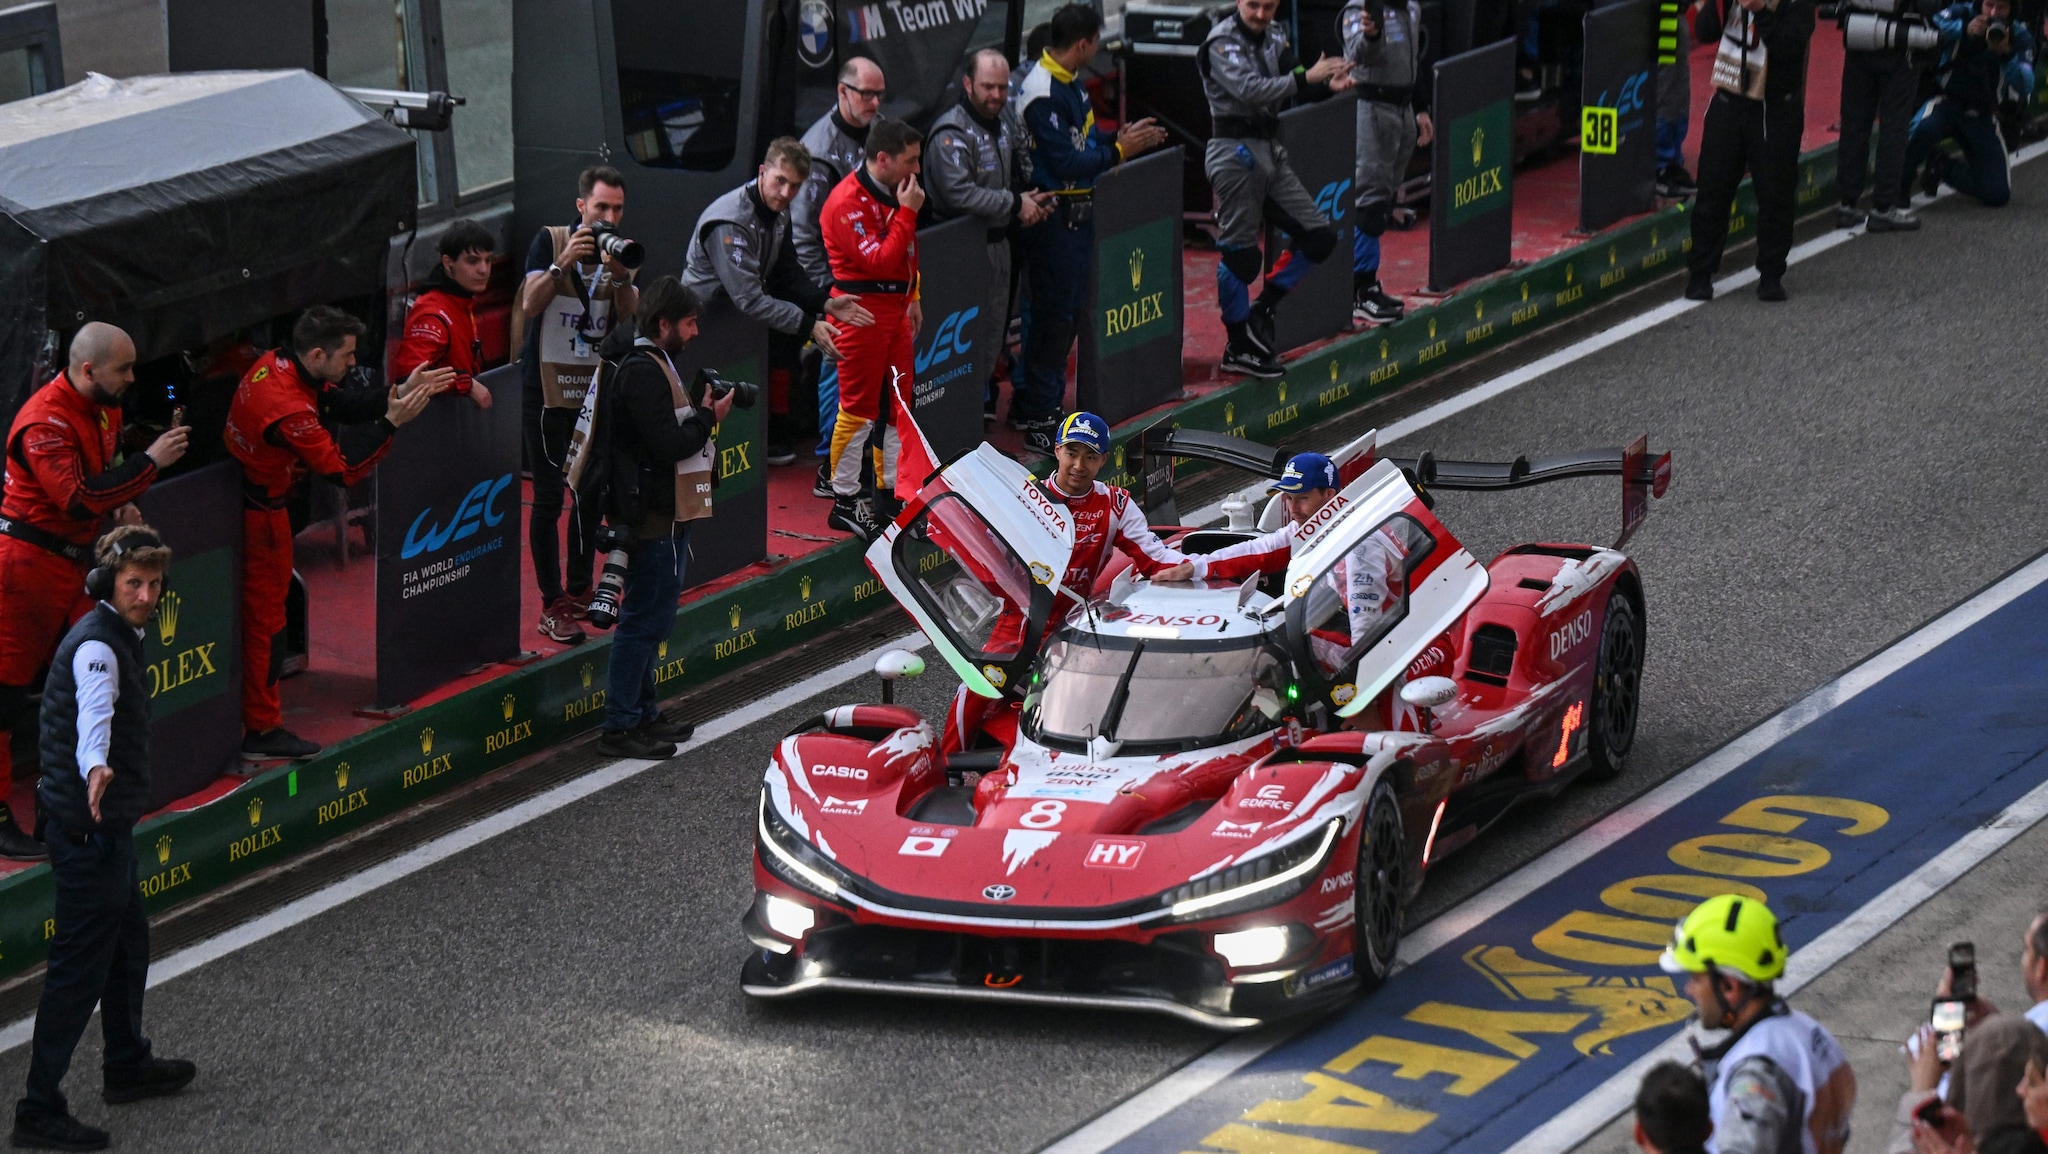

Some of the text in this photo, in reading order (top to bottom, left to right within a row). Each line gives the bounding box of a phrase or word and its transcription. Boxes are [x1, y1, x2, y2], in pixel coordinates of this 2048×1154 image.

[887, 0, 950, 33] Team
[1586, 113, 1613, 147] 38
[1315, 177, 1351, 220] EC
[1454, 166, 1502, 209] ROLEX
[1600, 266, 1626, 289] ROLEX
[1556, 283, 1583, 307] ROLEX
[1105, 291, 1163, 337] ROLEX
[1512, 303, 1539, 325] ROLEX
[1466, 321, 1493, 344] ROLEX
[1418, 339, 1447, 364] ROLEX
[1370, 361, 1399, 386] ROLEX
[913, 380, 933, 396] ORLD
[914, 387, 945, 408] PIONSHIP
[1319, 382, 1350, 407] ROLEX
[1267, 403, 1299, 429] ROLEX
[401, 472, 512, 560] WEC
[1023, 479, 1066, 533] TOYOTA
[1294, 495, 1349, 542] TOYOTA
[1076, 523, 1096, 532] ZENT
[403, 537, 503, 585] FIA WORLD ENDURANCE
[918, 550, 956, 575] ROLE
[402, 565, 470, 600] CHAMPIONSHIP
[854, 575, 885, 603] ROLE
[785, 600, 827, 631] ROLEX
[1104, 610, 1220, 626] DENSO
[715, 629, 757, 661] ROLEX
[1550, 609, 1592, 661] DENSO
[89, 661, 108, 674] FIA
[146, 642, 216, 699] OLEX
[654, 658, 686, 686] OLEX
[485, 719, 532, 754] ROLEX
[402, 752, 452, 788] ROLEX
[812, 764, 868, 781] CASIO
[1045, 778, 1098, 787] ZENT
[318, 788, 368, 825] ROLEX
[820, 806, 863, 815] MARELLI
[1019, 799, 1067, 829] 8
[1239, 798, 1294, 811] EDIFICE
[229, 824, 282, 862] ROLEX
[1211, 831, 1254, 839] MARELLI
[1090, 843, 1140, 864] HY
